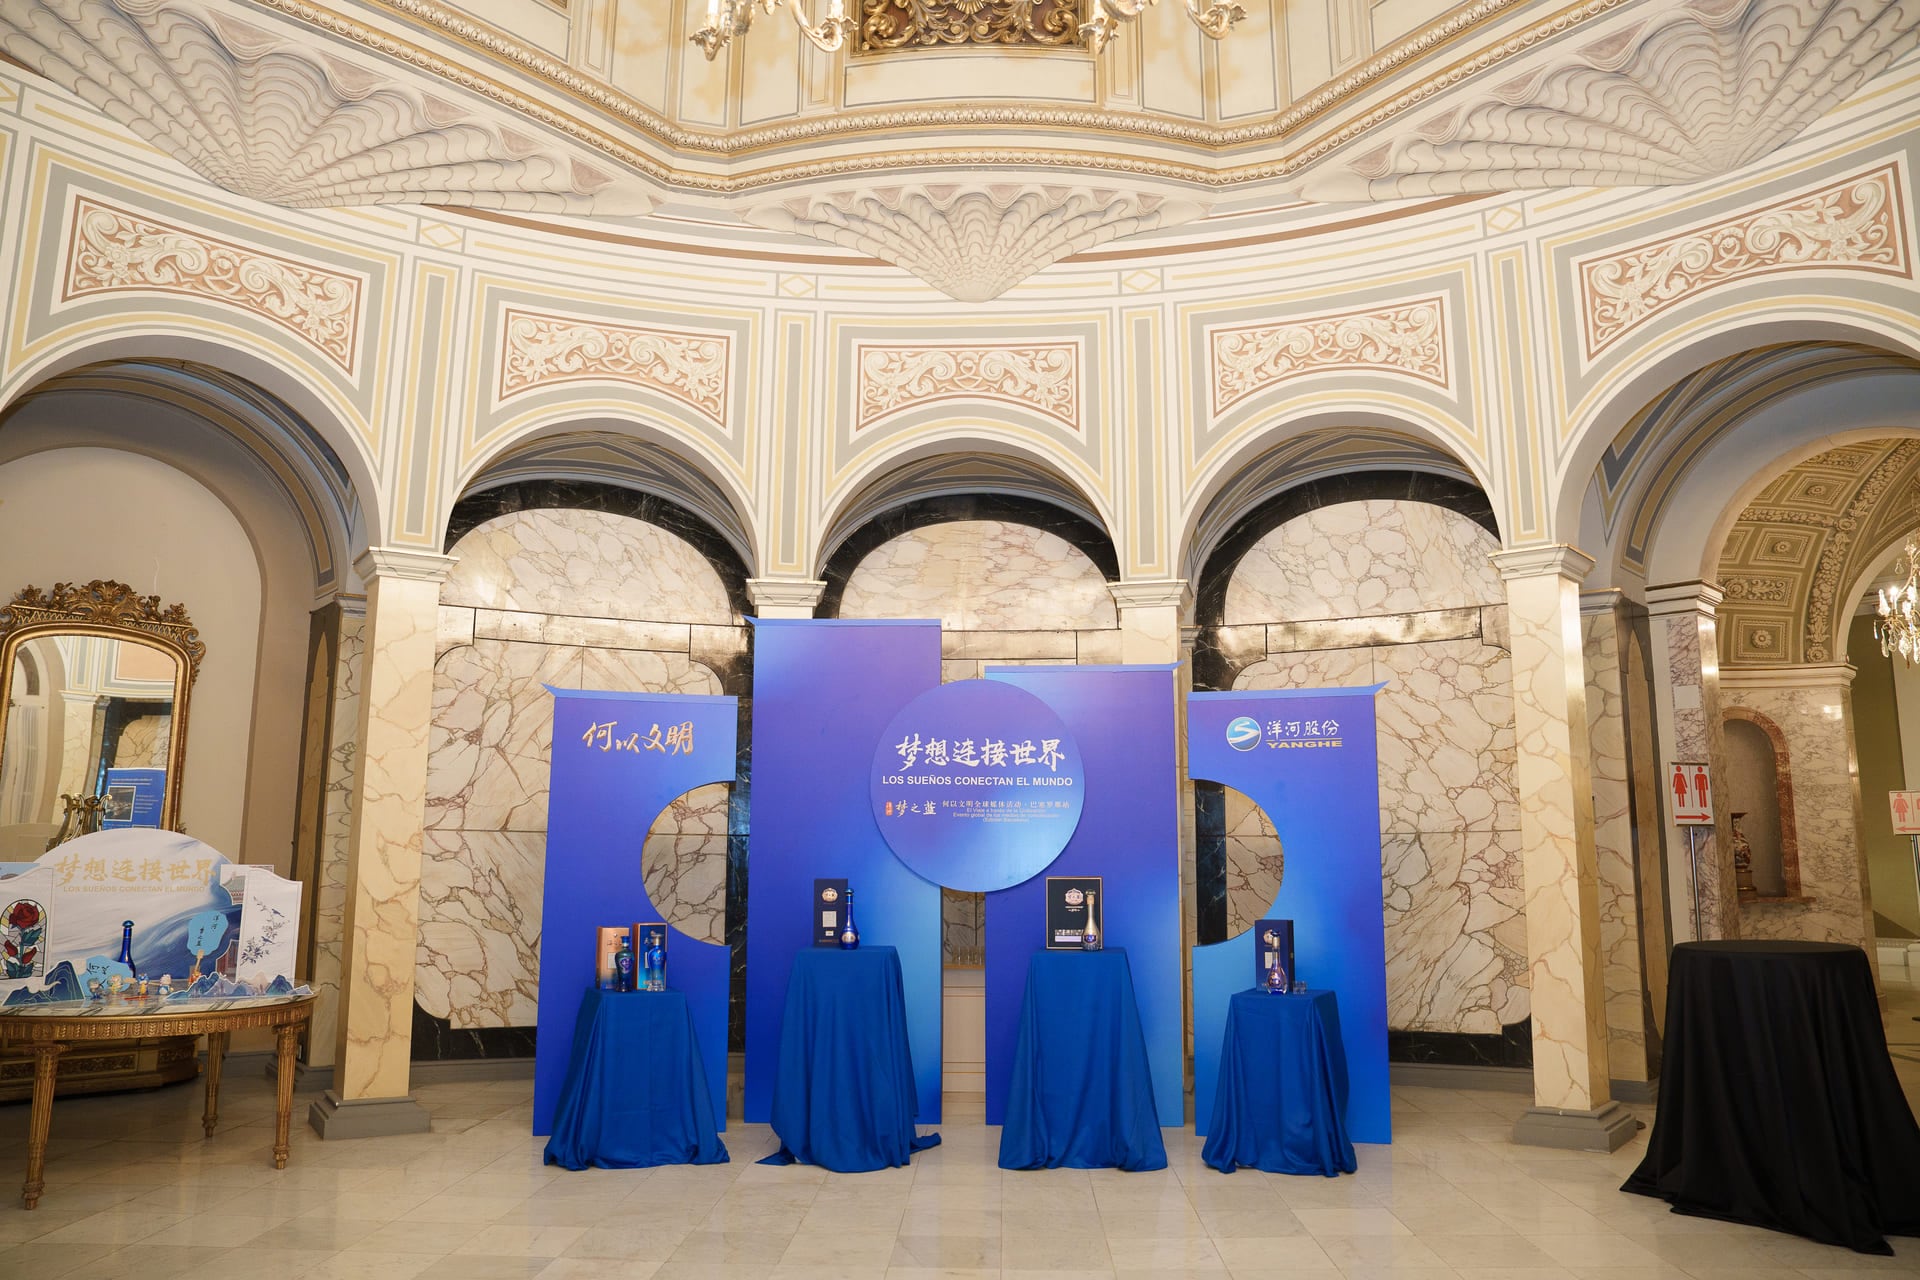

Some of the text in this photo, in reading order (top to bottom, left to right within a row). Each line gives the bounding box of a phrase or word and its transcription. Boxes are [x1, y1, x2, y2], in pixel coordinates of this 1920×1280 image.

[582, 720, 694, 756] 何以文明
[1266, 719, 1340, 741] 洋河股份
[895, 732, 1066, 773] 梦想连接世界
[1267, 741, 1343, 749] YANGHE
[882, 774, 1073, 787] LOS SUEÑOS CONECTAN EL MUNDO
[895, 799, 937, 818] 梦之蓝
[54, 852, 216, 887] 梦想连接世界
[63, 885, 80, 893] LOS
[119, 885, 162, 893] CONECTAN
